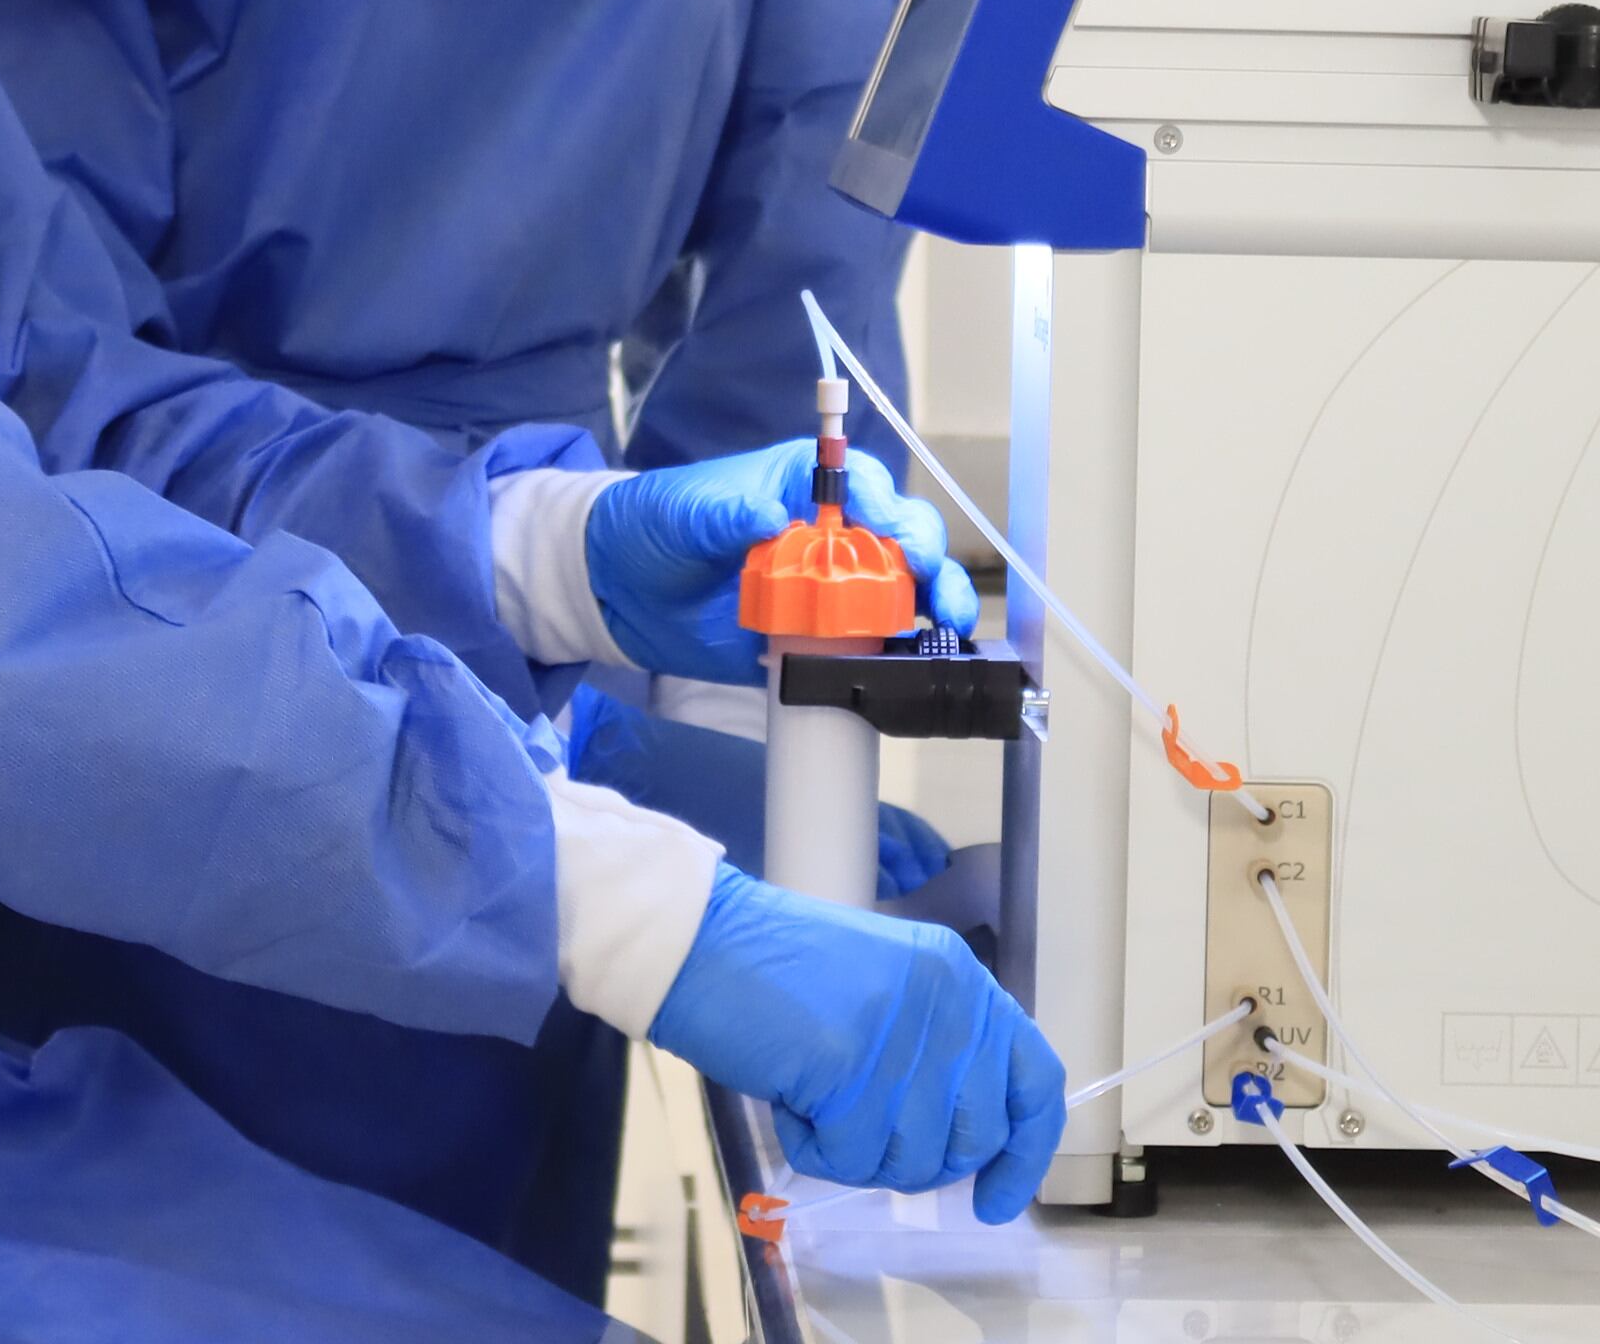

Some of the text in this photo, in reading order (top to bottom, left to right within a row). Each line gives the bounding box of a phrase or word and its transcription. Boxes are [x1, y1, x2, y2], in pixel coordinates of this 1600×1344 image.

[1279, 800, 1307, 819] C1
[1277, 862, 1306, 881] C2
[1258, 986, 1286, 1005] R1
[1280, 1027, 1312, 1045] UV
